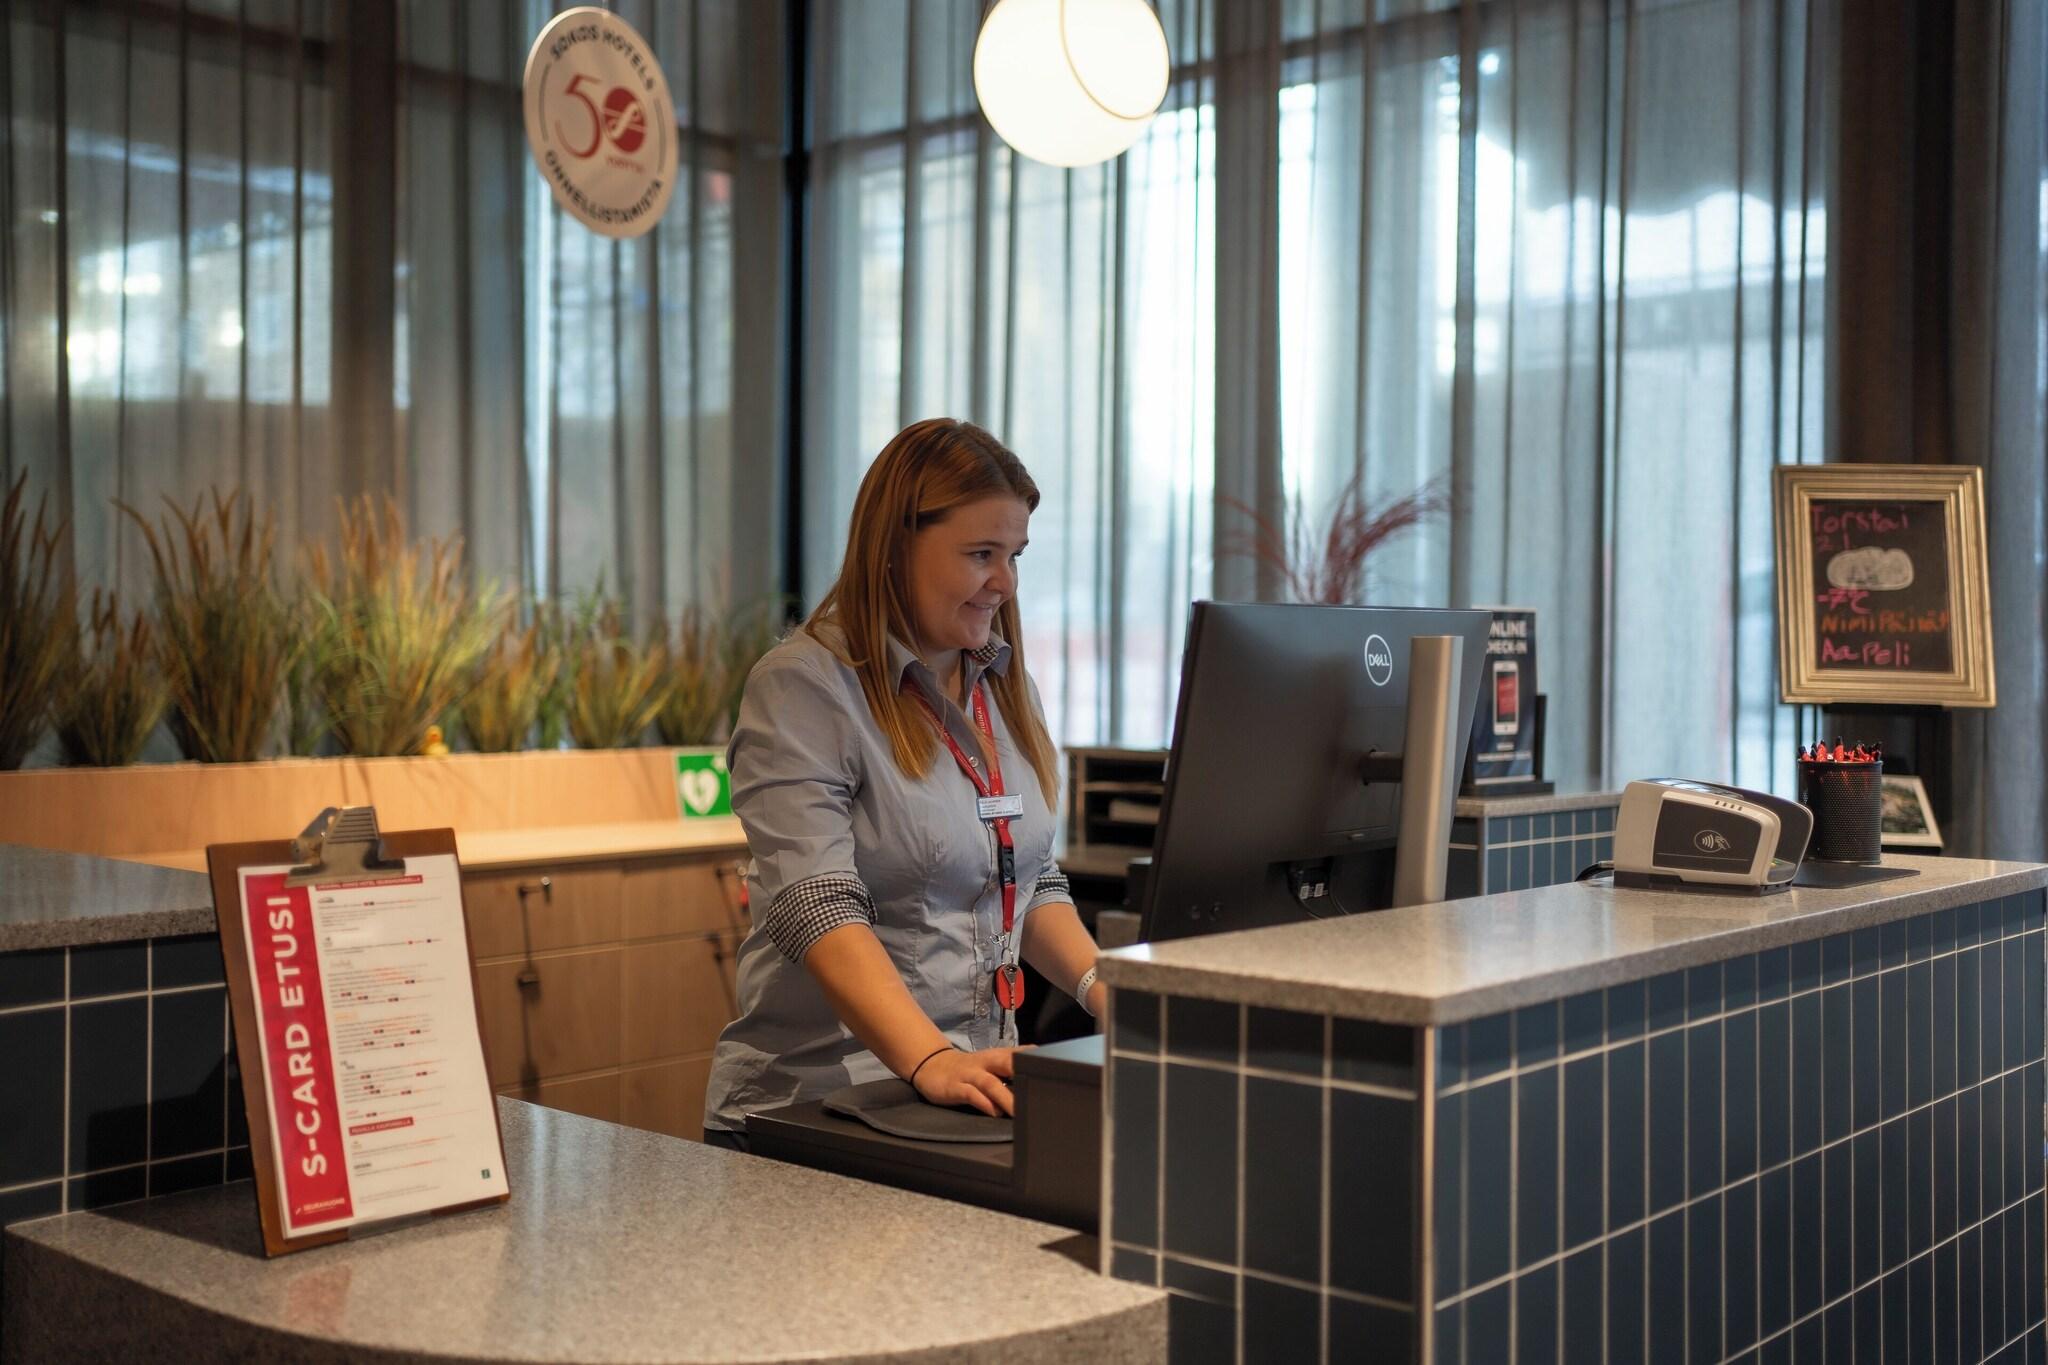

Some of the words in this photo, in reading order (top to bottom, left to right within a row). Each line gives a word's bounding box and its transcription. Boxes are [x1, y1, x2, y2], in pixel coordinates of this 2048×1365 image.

[550, 24, 600, 60] SOKOS
[602, 30, 655, 91] HOTELS
[1811, 504, 1909, 534] Torstai
[1489, 620, 1527, 637] NLINE
[1368, 654, 1389, 666] DELL
[266, 896, 304, 1008] ETUSI
[284, 1023, 328, 1177] S-CARD
